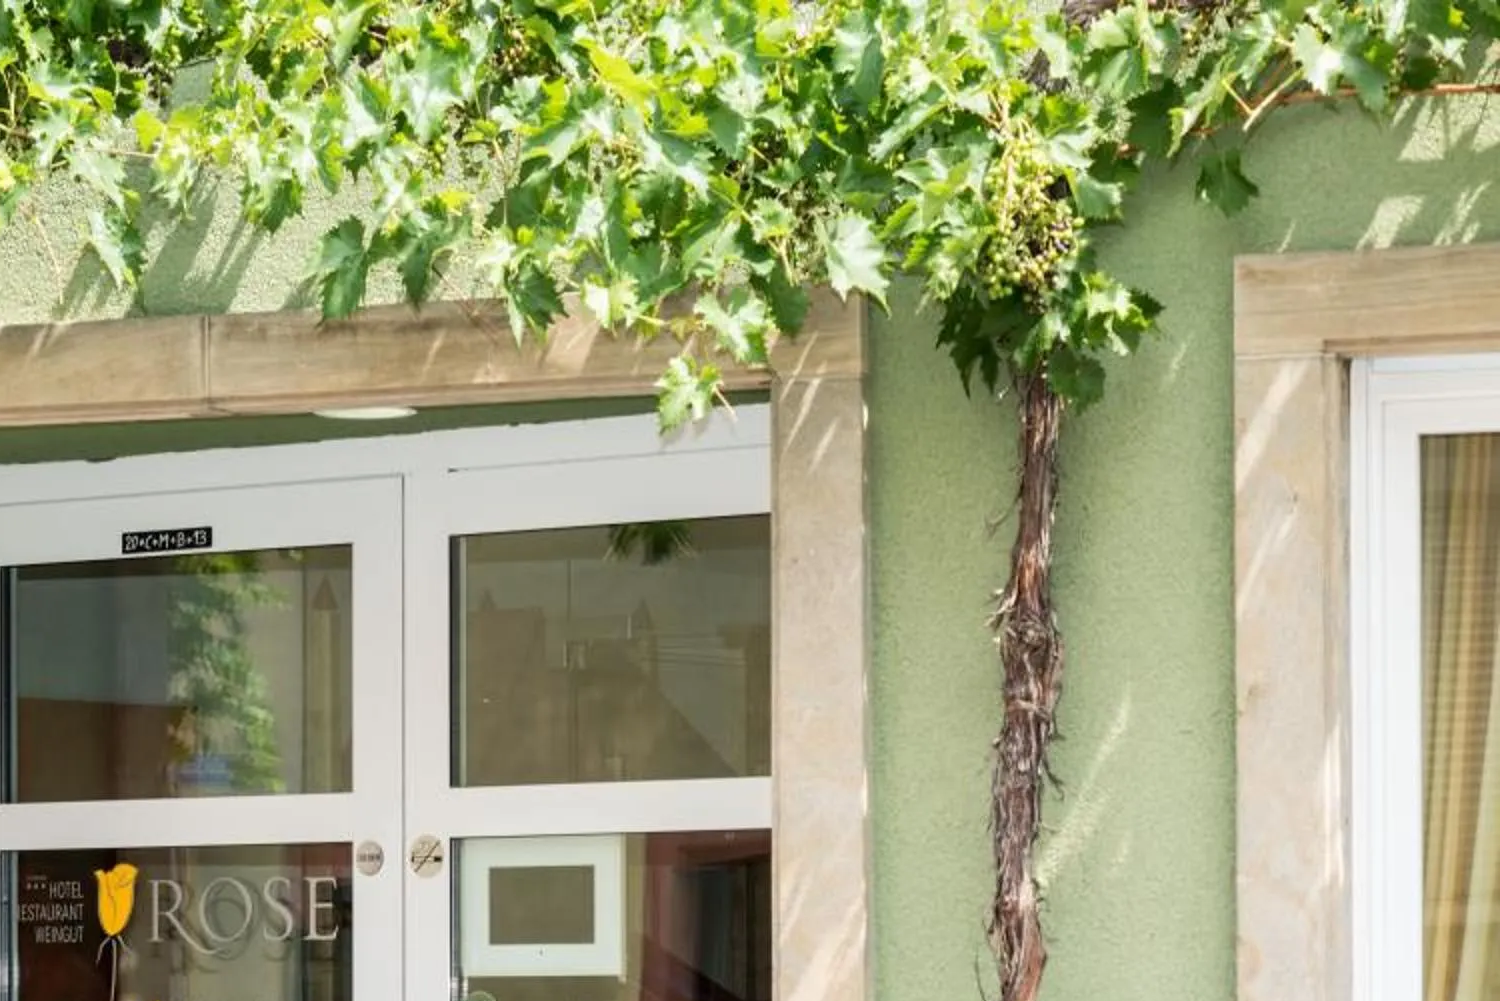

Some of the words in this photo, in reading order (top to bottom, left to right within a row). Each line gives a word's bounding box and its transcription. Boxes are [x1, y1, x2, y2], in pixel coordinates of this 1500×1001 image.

[49, 881, 84, 899] HOTEL
[149, 876, 340, 954] ROSE
[35, 925, 85, 943] WEINGUT
